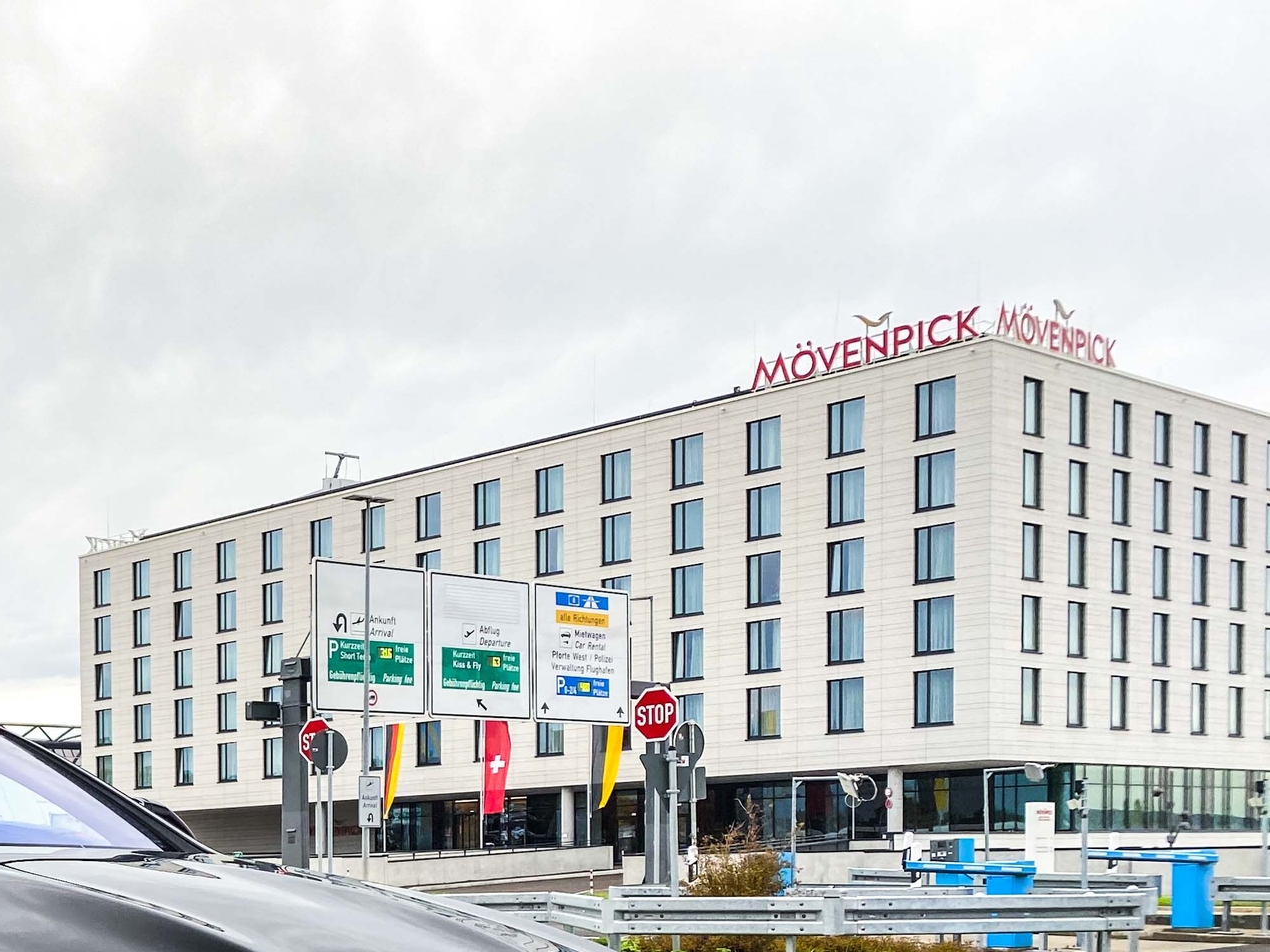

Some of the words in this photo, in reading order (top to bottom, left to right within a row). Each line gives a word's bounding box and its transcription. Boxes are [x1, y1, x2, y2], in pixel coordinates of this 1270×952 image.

[995, 300, 1117, 368] MÖVENPICK
[750, 305, 981, 393] MÖVENPICK
[369, 614, 396, 626] Ankunft
[559, 613, 572, 622] alle
[573, 613, 606, 626] Richtungen
[369, 627, 394, 638] Arrival
[479, 625, 500, 637] Abflug
[574, 629, 606, 641] Mietwagen
[479, 637, 512, 648] Departure
[574, 640, 586, 650] Car
[587, 641, 606, 651] Rental
[329, 640, 339, 659] P
[395, 644, 409, 654] freie
[452, 650, 476, 659] Kurzzeit
[340, 651, 357, 661] Short
[395, 655, 413, 664] Plätze
[502, 653, 516, 662] freie
[551, 650, 571, 661] Pforte
[572, 653, 588, 662] West
[594, 653, 614, 664] Polizei
[452, 660, 466, 669] Kiss
[472, 661, 482, 672] Fly
[502, 663, 520, 672] Plätze
[551, 662, 585, 675] Verwaltung
[585, 664, 615, 676] Flughafen
[382, 673, 403, 686] Parking
[404, 675, 413, 685] fee
[592, 679, 605, 688] freie
[491, 680, 511, 693] Parking
[510, 682, 520, 692] fee
[637, 702, 674, 726] STOP
[302, 732, 316, 751] ST
